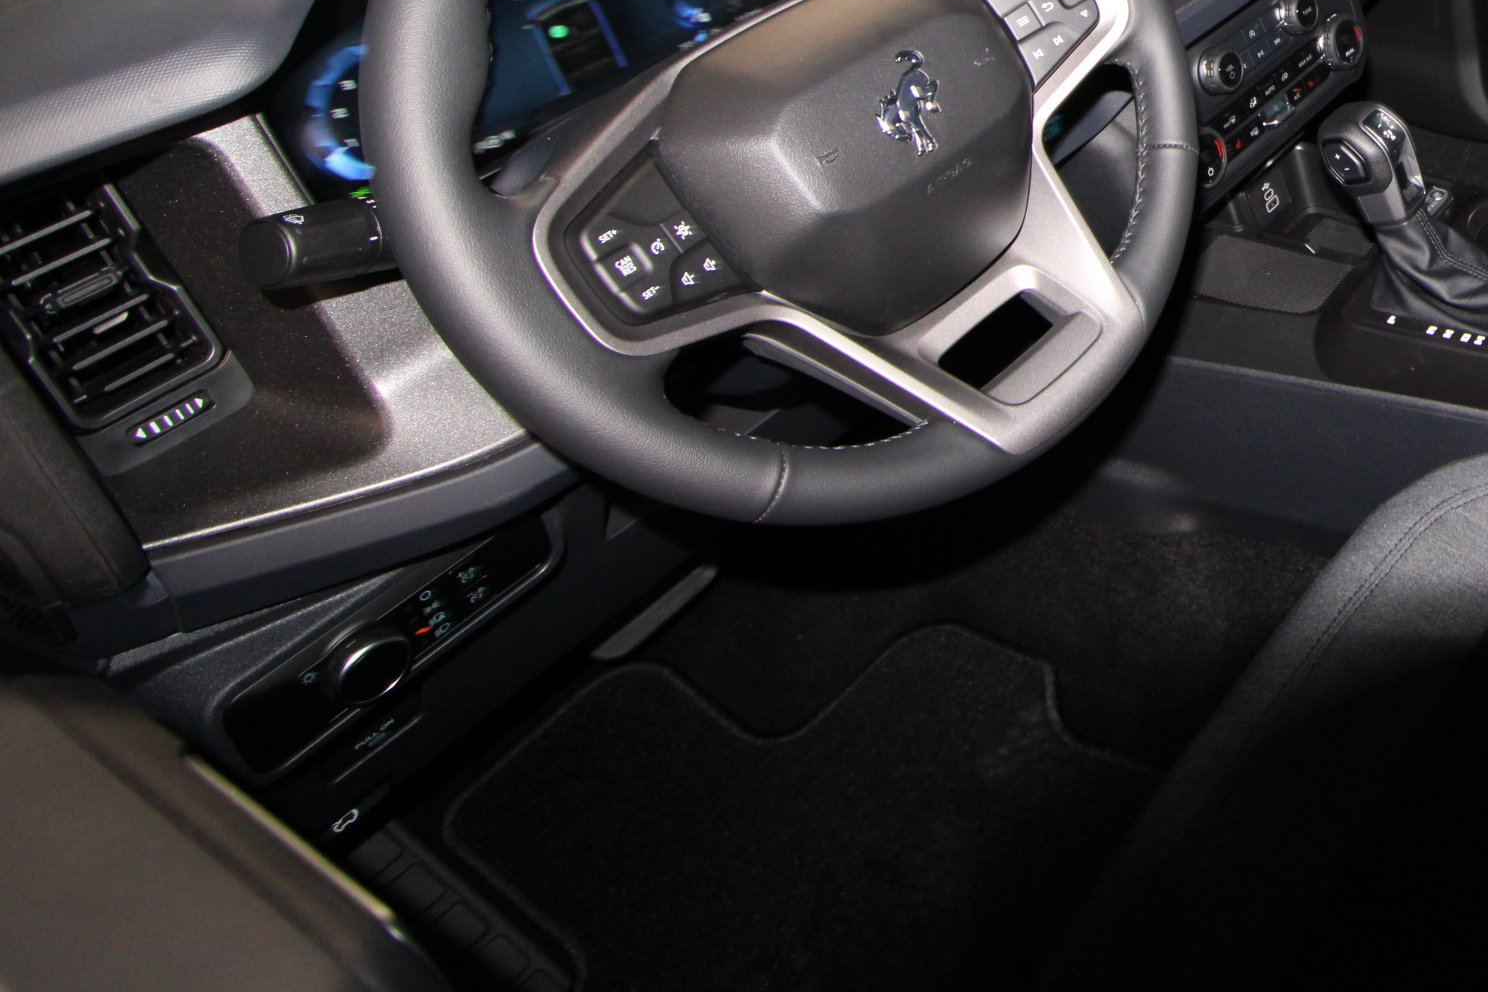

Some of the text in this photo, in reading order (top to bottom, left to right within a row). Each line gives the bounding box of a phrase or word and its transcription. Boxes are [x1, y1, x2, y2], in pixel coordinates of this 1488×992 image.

[1264, 84, 1276, 96] AUTO
[597, 229, 618, 244] SET+
[614, 254, 633, 270] CAN
[621, 264, 638, 277] RES
[641, 285, 661, 300] SET-
[380, 717, 395, 731] ON
